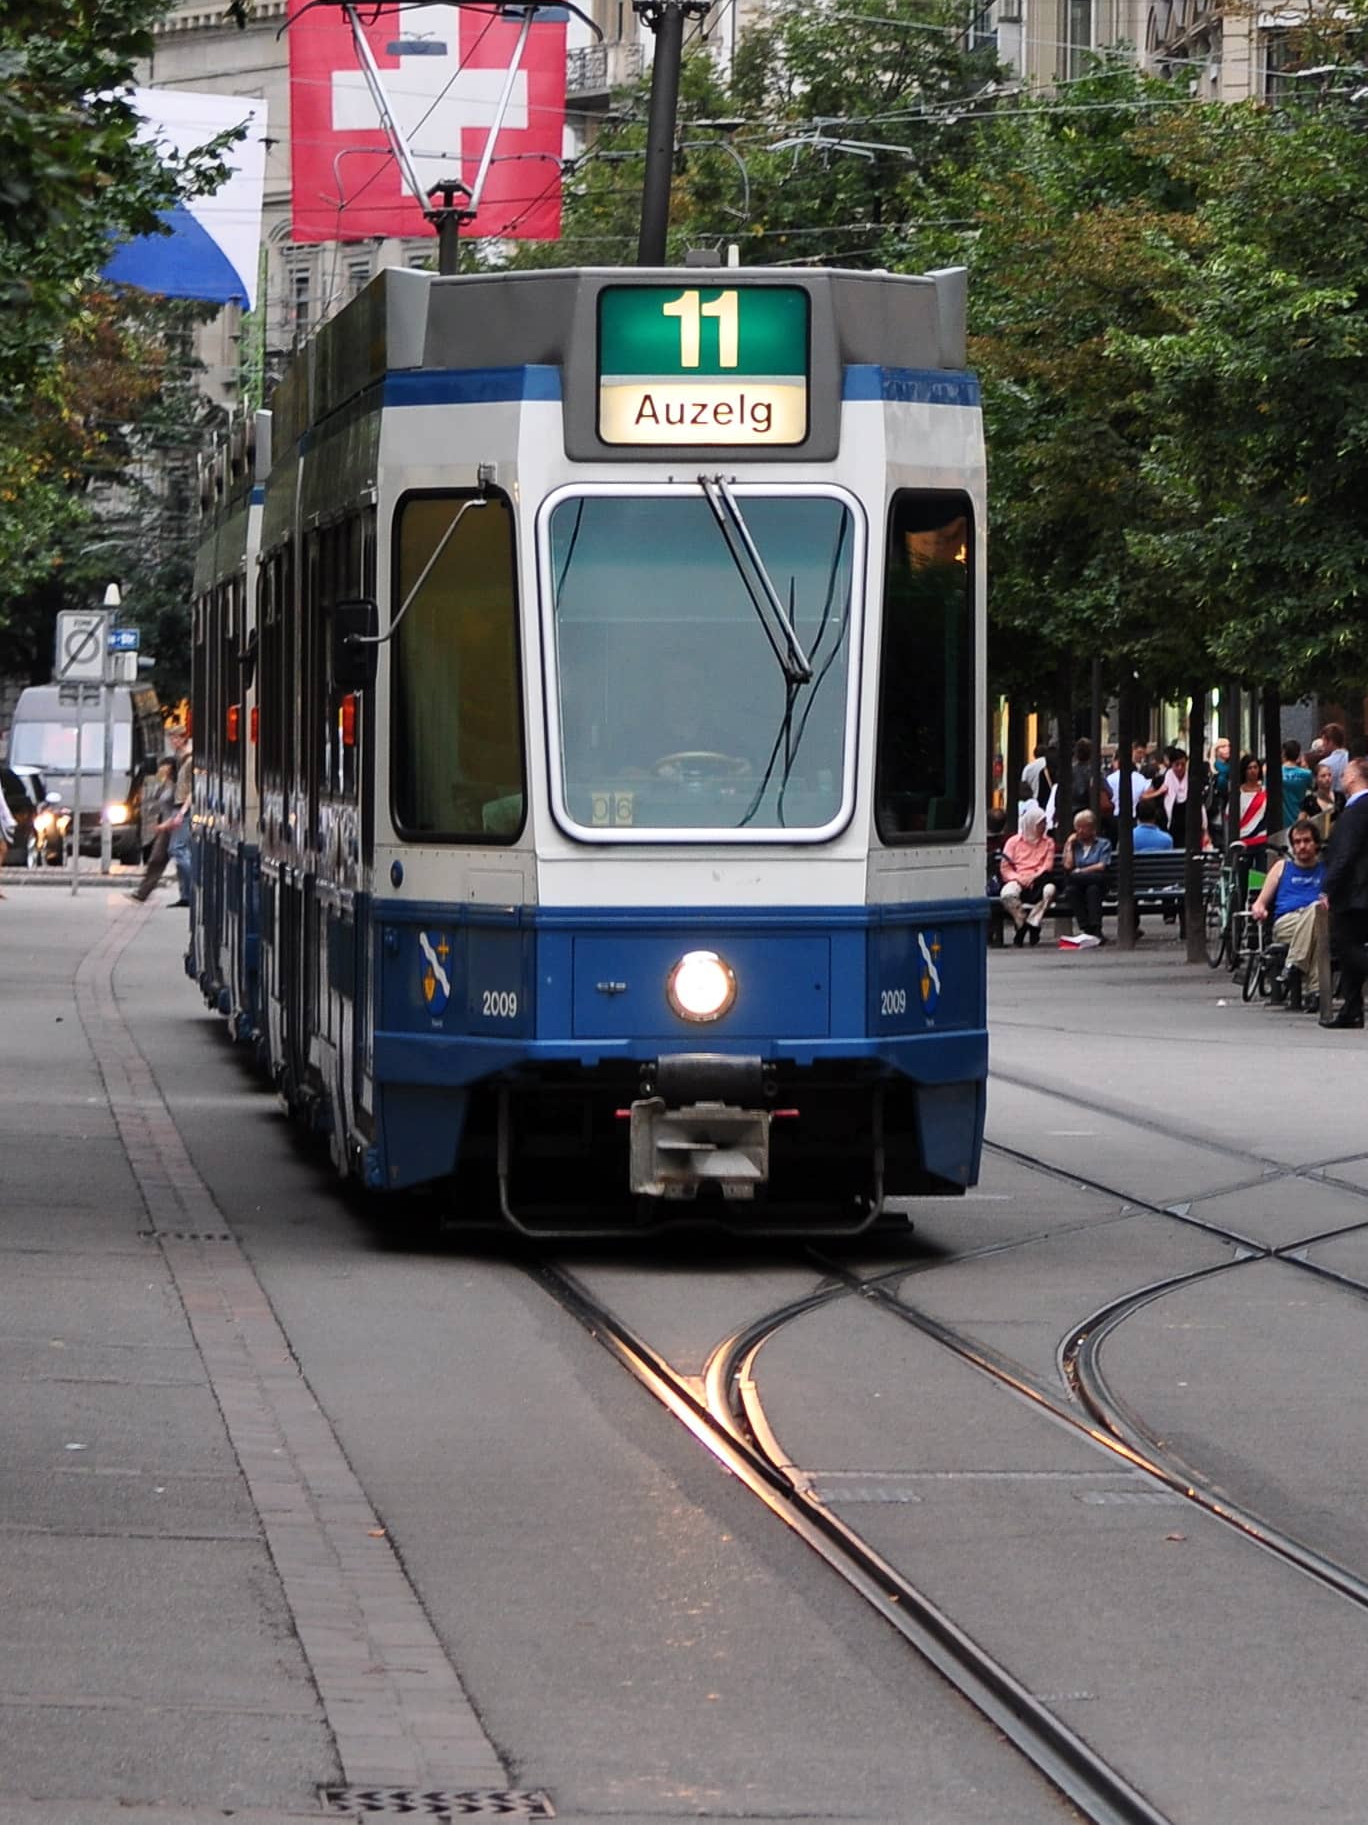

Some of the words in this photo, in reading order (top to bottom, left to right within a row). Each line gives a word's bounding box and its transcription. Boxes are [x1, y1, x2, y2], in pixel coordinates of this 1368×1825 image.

[662, 289, 739, 369] 11
[635, 393, 773, 433] Auzelg
[483, 990, 517, 1018] 2009
[881, 989, 906, 1016] 2009
